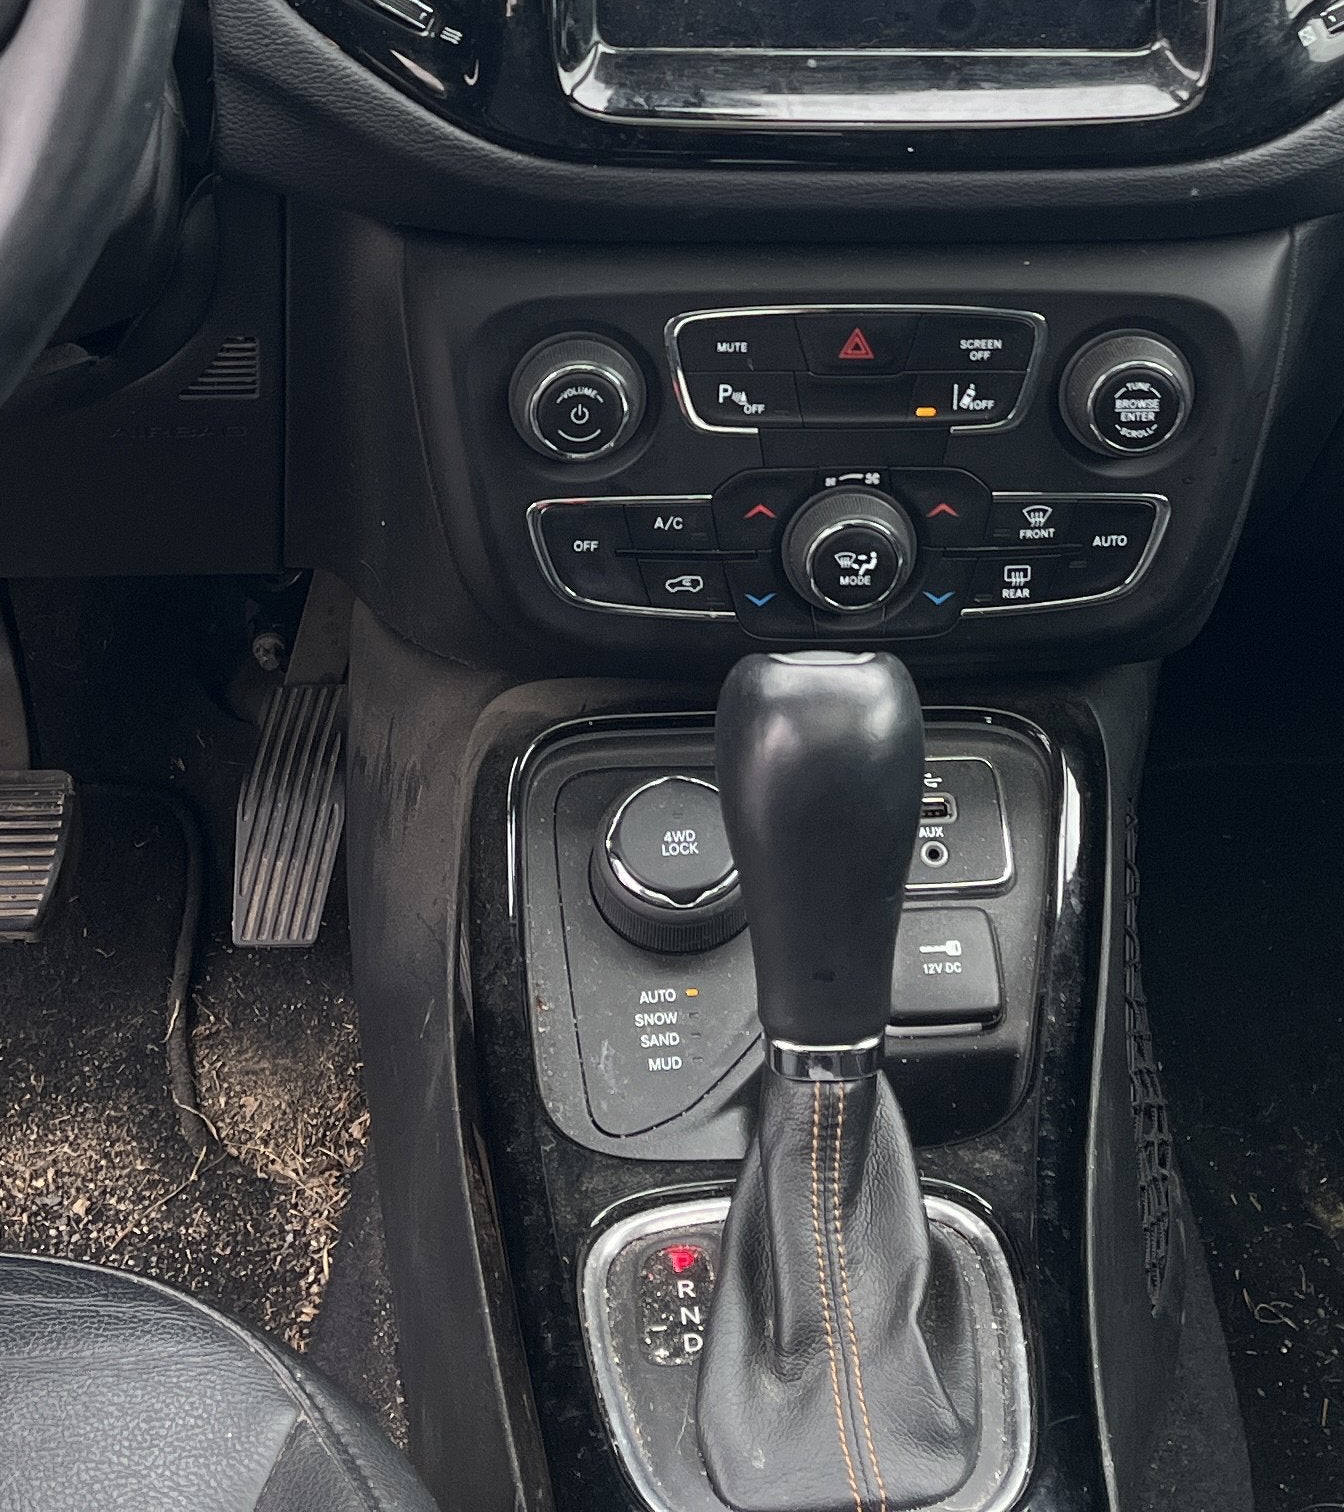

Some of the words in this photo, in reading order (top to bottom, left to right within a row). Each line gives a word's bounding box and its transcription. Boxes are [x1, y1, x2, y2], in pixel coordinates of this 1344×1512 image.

[716, 341, 749, 353] MUTE
[959, 339, 1003, 350] SCREEN
[969, 350, 992, 361] OFF
[561, 386, 598, 399] VOLUME
[1125, 381, 1151, 392] TUNE
[743, 403, 766, 415] OFF
[1115, 398, 1160, 409] BROWSE
[1120, 411, 1156, 422] ENTER
[1119, 427, 1155, 439] SCROLL
[653, 515, 684, 531] A/C
[1019, 527, 1056, 540] FRONT
[573, 540, 599, 553] OFF
[1092, 534, 1128, 547] AUTO
[839, 575, 872, 586] MODE
[1001, 588, 1031, 599] REAR
[663, 829, 697, 843] 4WD
[918, 826, 945, 838] AUX
[661, 841, 699, 857] LOCK
[922, 962, 943, 975] 12V
[945, 961, 962, 974] DC
[639, 988, 677, 1005] AUTO
[634, 1011, 678, 1028] SNOW
[640, 1032, 680, 1048] SAND
[647, 1055, 683, 1072] MUD
[677, 1279, 697, 1299] R
[680, 1306, 701, 1326] N
[683, 1333, 704, 1353] D
